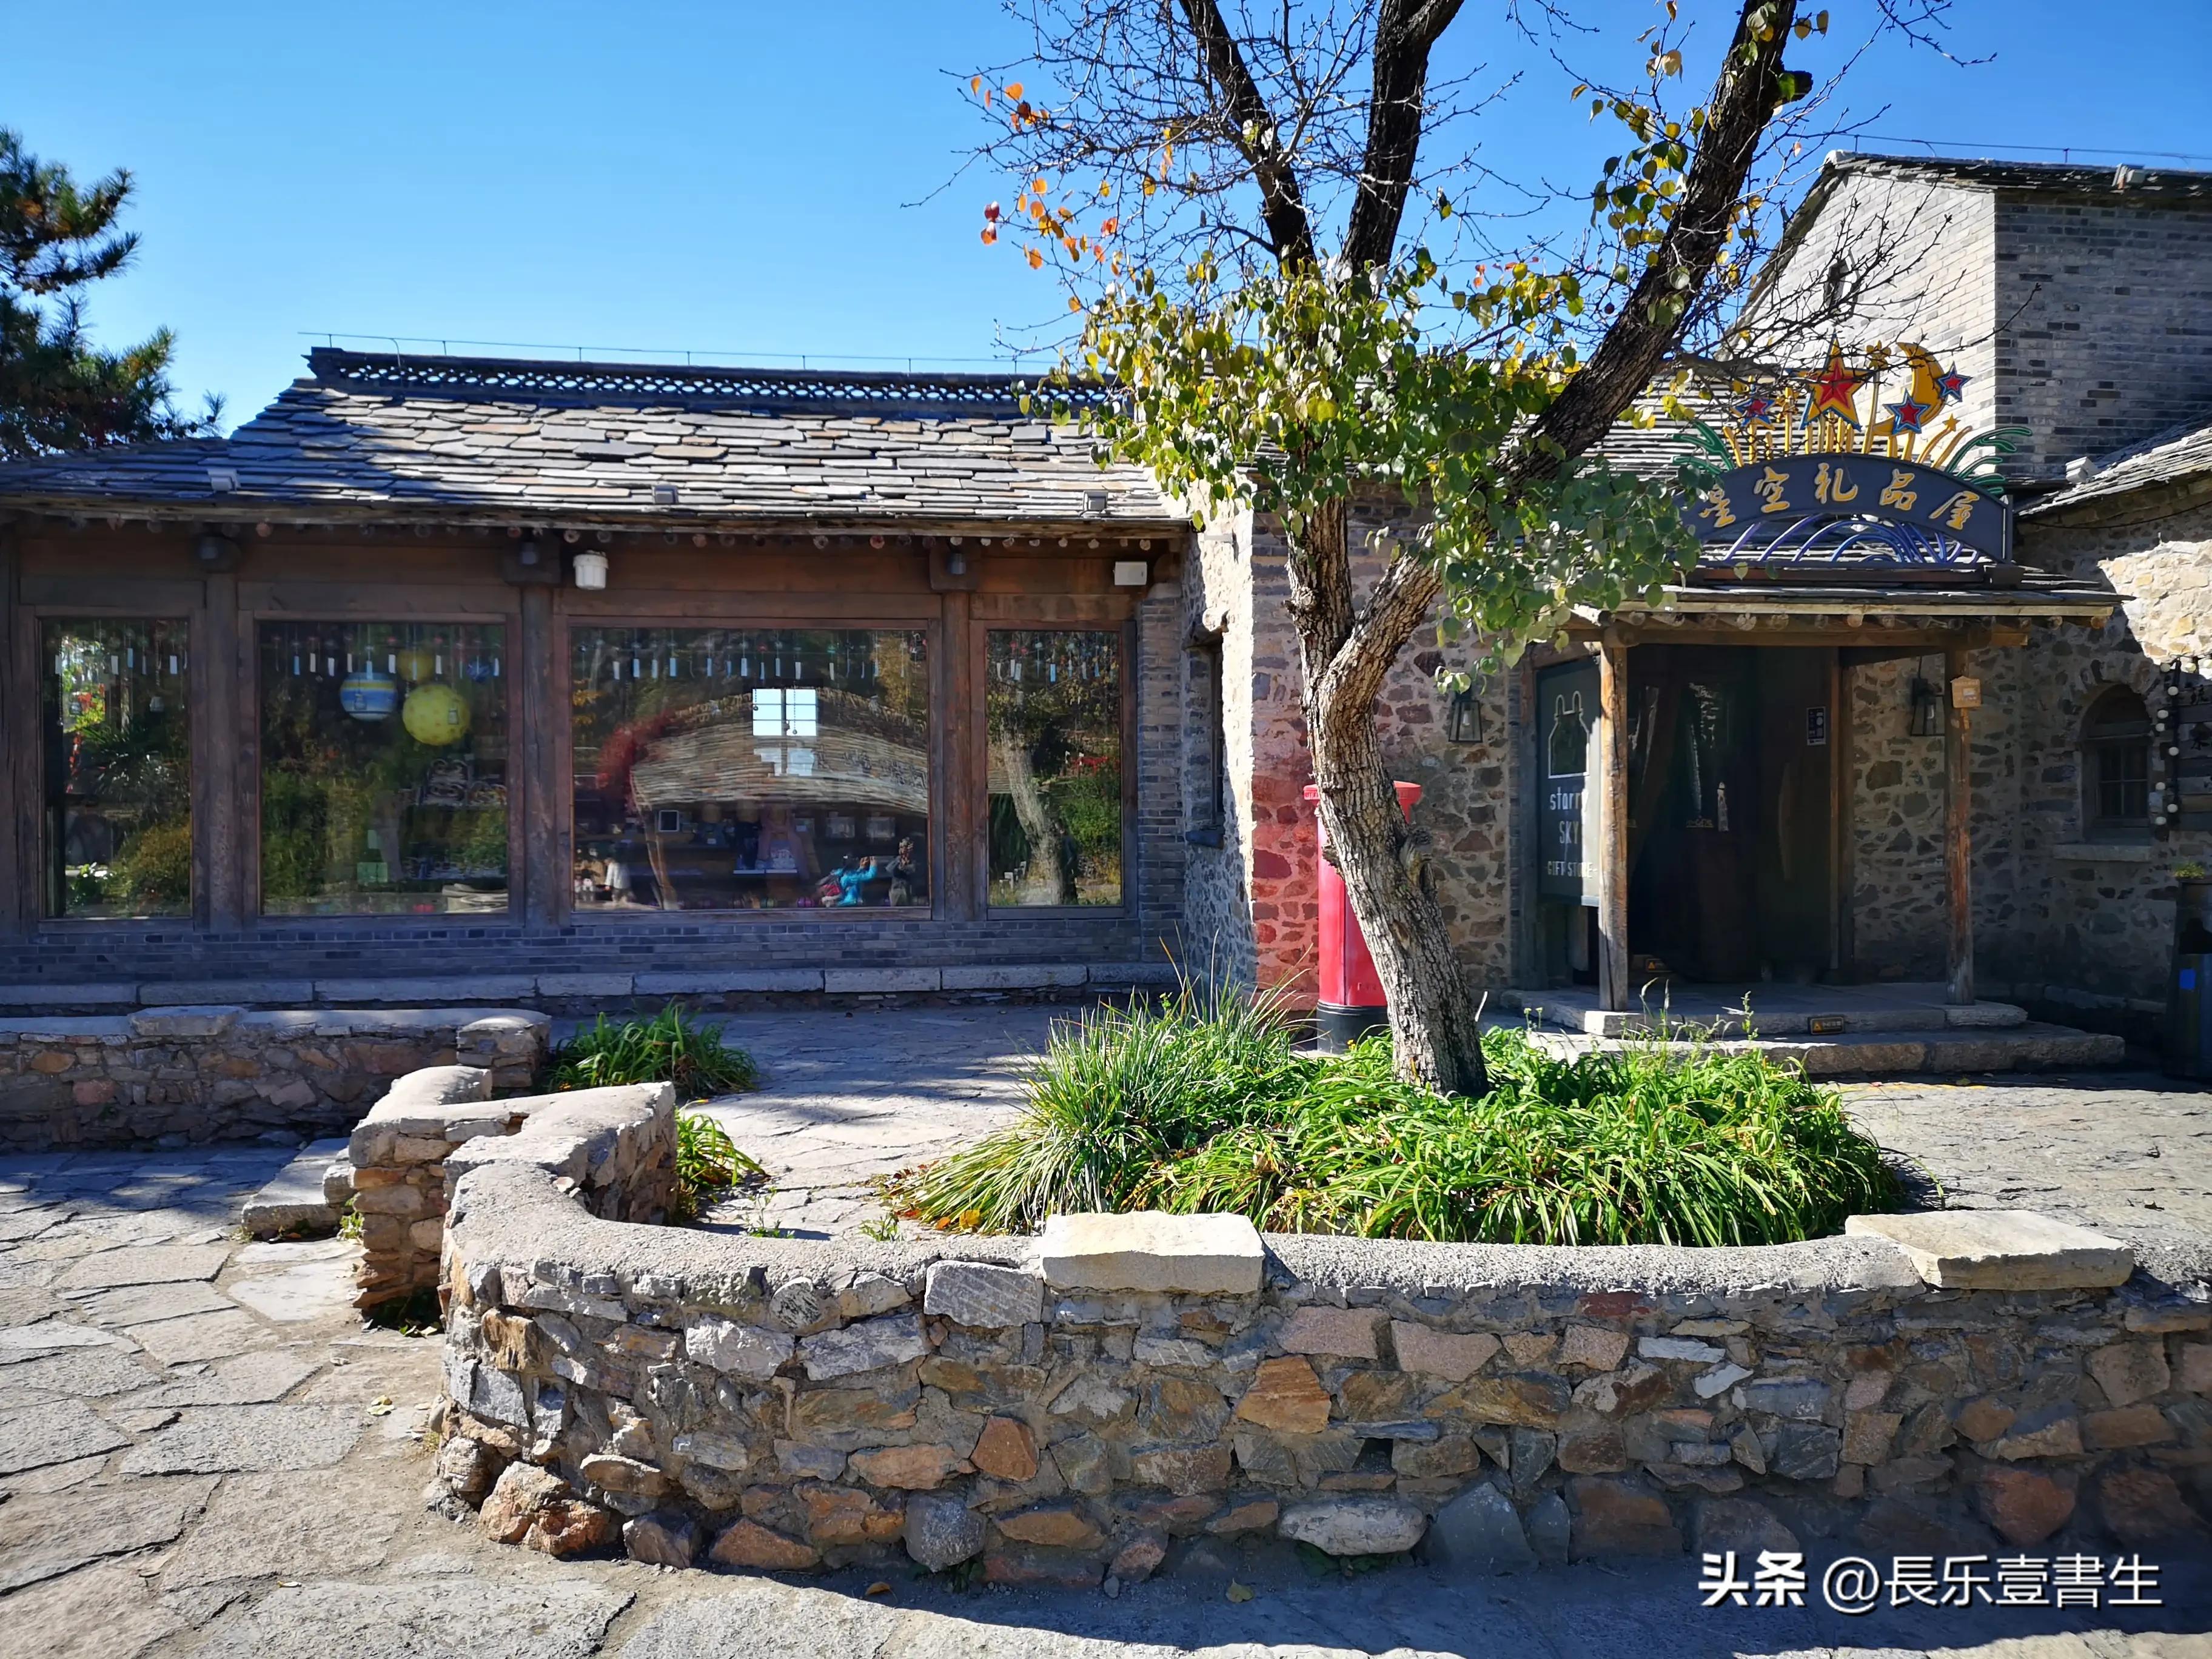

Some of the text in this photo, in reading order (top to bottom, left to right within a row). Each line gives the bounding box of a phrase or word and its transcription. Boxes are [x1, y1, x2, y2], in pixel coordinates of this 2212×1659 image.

[1698, 461, 1980, 531] 星空礼品屋
[1559, 820, 1579, 845] SKY
